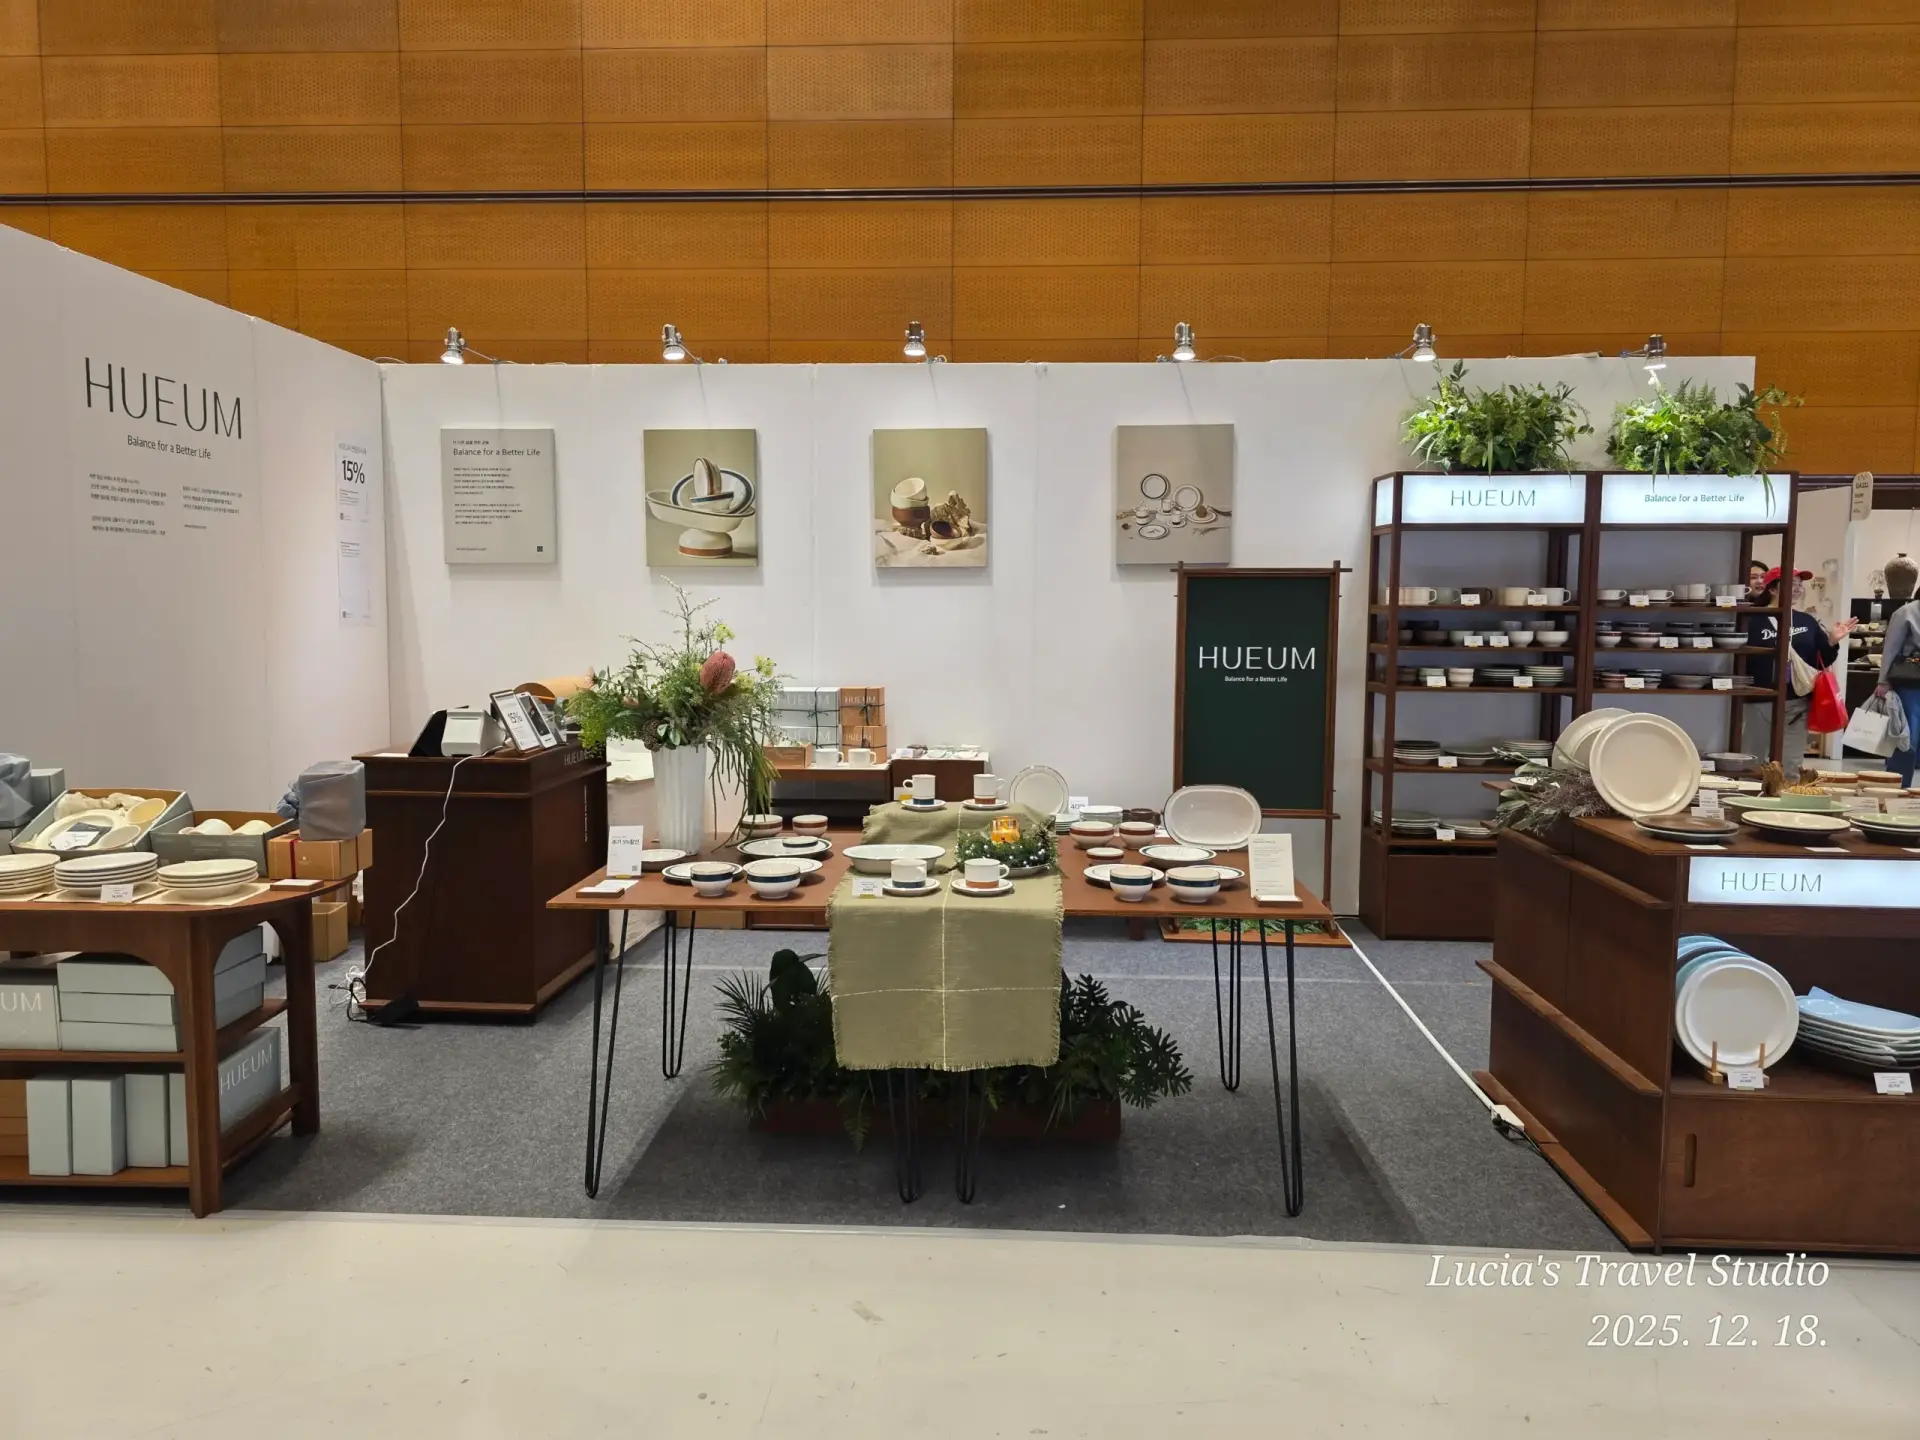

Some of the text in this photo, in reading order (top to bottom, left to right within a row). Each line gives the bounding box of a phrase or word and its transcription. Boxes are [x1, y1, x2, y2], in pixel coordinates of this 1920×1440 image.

[85, 357, 241, 439] HUEUM
[127, 435, 212, 460] Balance for a Better Life
[453, 448, 482, 456] Balance
[483, 448, 494, 456] for
[342, 460, 365, 484] 15%
[1450, 490, 1536, 506] HUEUM
[1644, 494, 1677, 502] Balance
[1679, 494, 1691, 502] for
[1700, 494, 1726, 502] Better
[1728, 494, 1744, 502] Life
[1199, 646, 1316, 670] HUEUM
[1722, 872, 1821, 892] HUEUM
[220, 1043, 273, 1096] HUEUM
